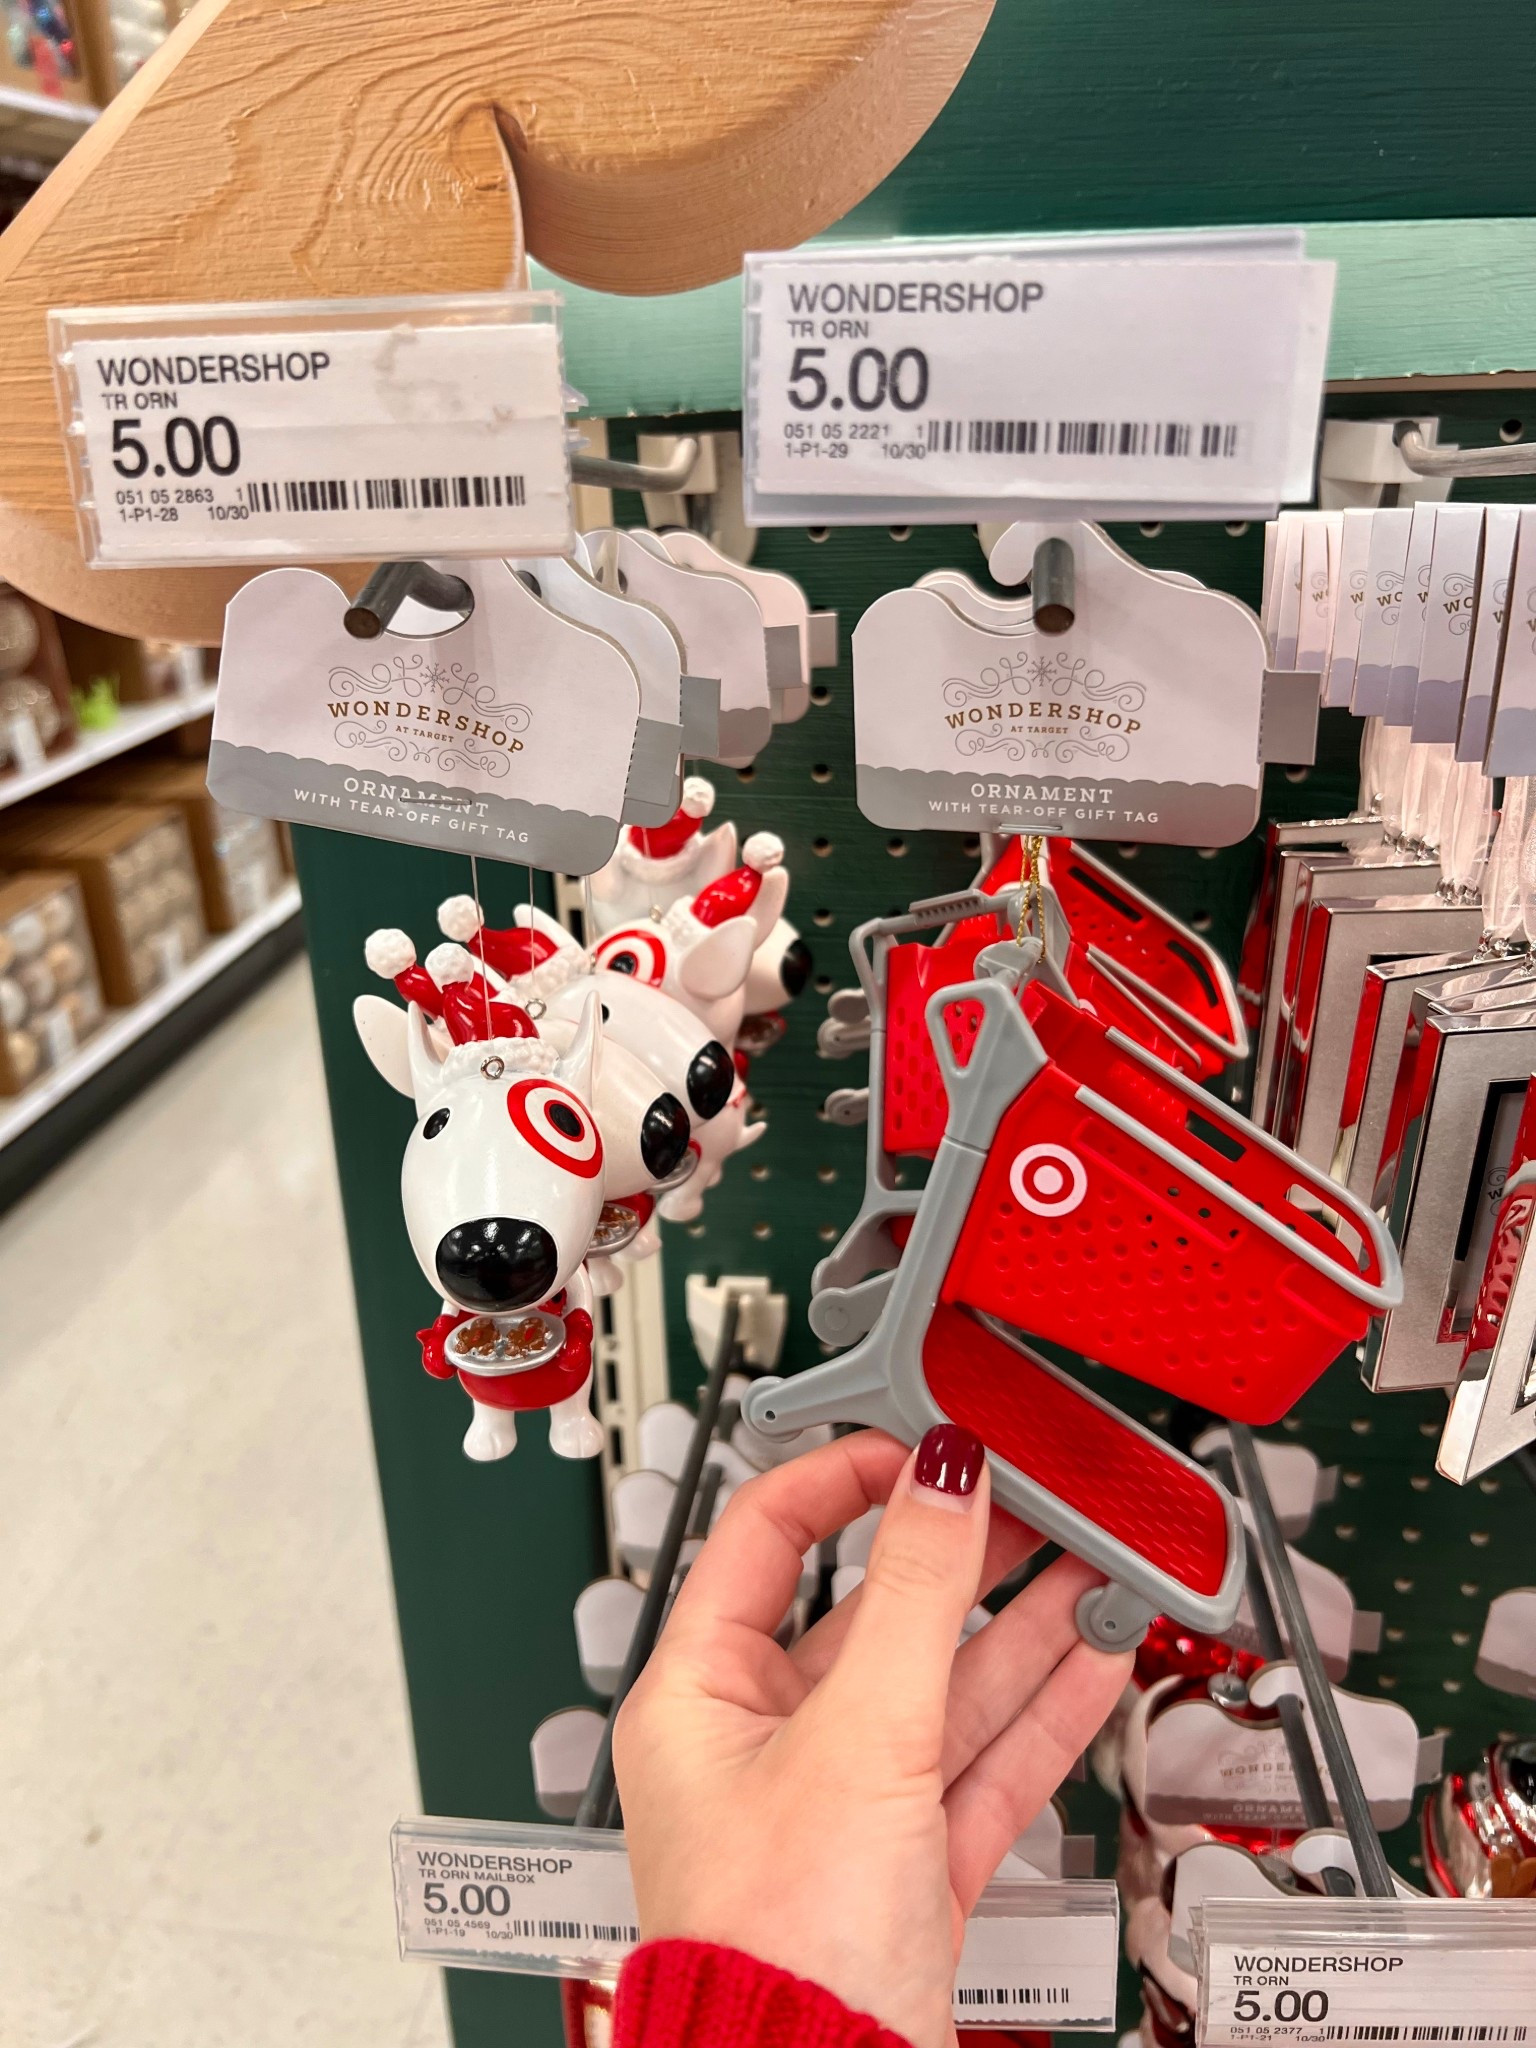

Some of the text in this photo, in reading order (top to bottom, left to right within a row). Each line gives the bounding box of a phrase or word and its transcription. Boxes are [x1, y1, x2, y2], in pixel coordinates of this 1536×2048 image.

[787, 281, 1045, 313] WONDERSHOP
[787, 318, 870, 339] TR ORN
[97, 352, 331, 387] WONDERSHOP
[786, 346, 930, 412] 5.00
[102, 391, 179, 411] TR ORN
[784, 423, 813, 439] 051
[821, 423, 843, 439] 05
[849, 423, 890, 440] 2221
[111, 414, 241, 478] 5.00
[785, 442, 927, 460] 1-P1-29 10/30
[116, 489, 144, 505] 051
[150, 488, 170, 504] 05
[175, 488, 214, 504] 2863
[119, 505, 250, 522] 1-P1-28 10/30
[327, 701, 525, 754] WONDERSHOP
[944, 702, 1142, 735] WONDERSHOP
[396, 725, 454, 743] AT TARGET
[1010, 725, 1069, 735] AT TARGET
[343, 778, 489, 818] ORNAMENT
[971, 783, 1113, 804] ORNAMENT
[294, 789, 529, 844] WITH TEAR-OFF GIFT TAG
[928, 800, 1159, 824] WITH TEAR-OFF GIFT TAG
[417, 1851, 573, 1874] WONDERSHOP
[419, 1868, 536, 1884] TR ORN MAILBOX
[424, 1882, 511, 1917] 5.00
[424, 1918, 443, 1928] 051
[447, 1919, 461, 1928] 05
[464, 1920, 491, 1929] 4569
[426, 1927, 514, 1940] 1-P1-19 10/30
[1234, 1955, 1404, 1973] WONDERSHOP
[1233, 1975, 1289, 1986] TR ORN
[1233, 1989, 1329, 2022] 5.00
[1230, 2026, 1251, 2034] 051
[1255, 2026, 1270, 2034] 05
[1274, 2027, 1303, 2035] 2377
[1295, 2035, 1326, 2043] 10/30
